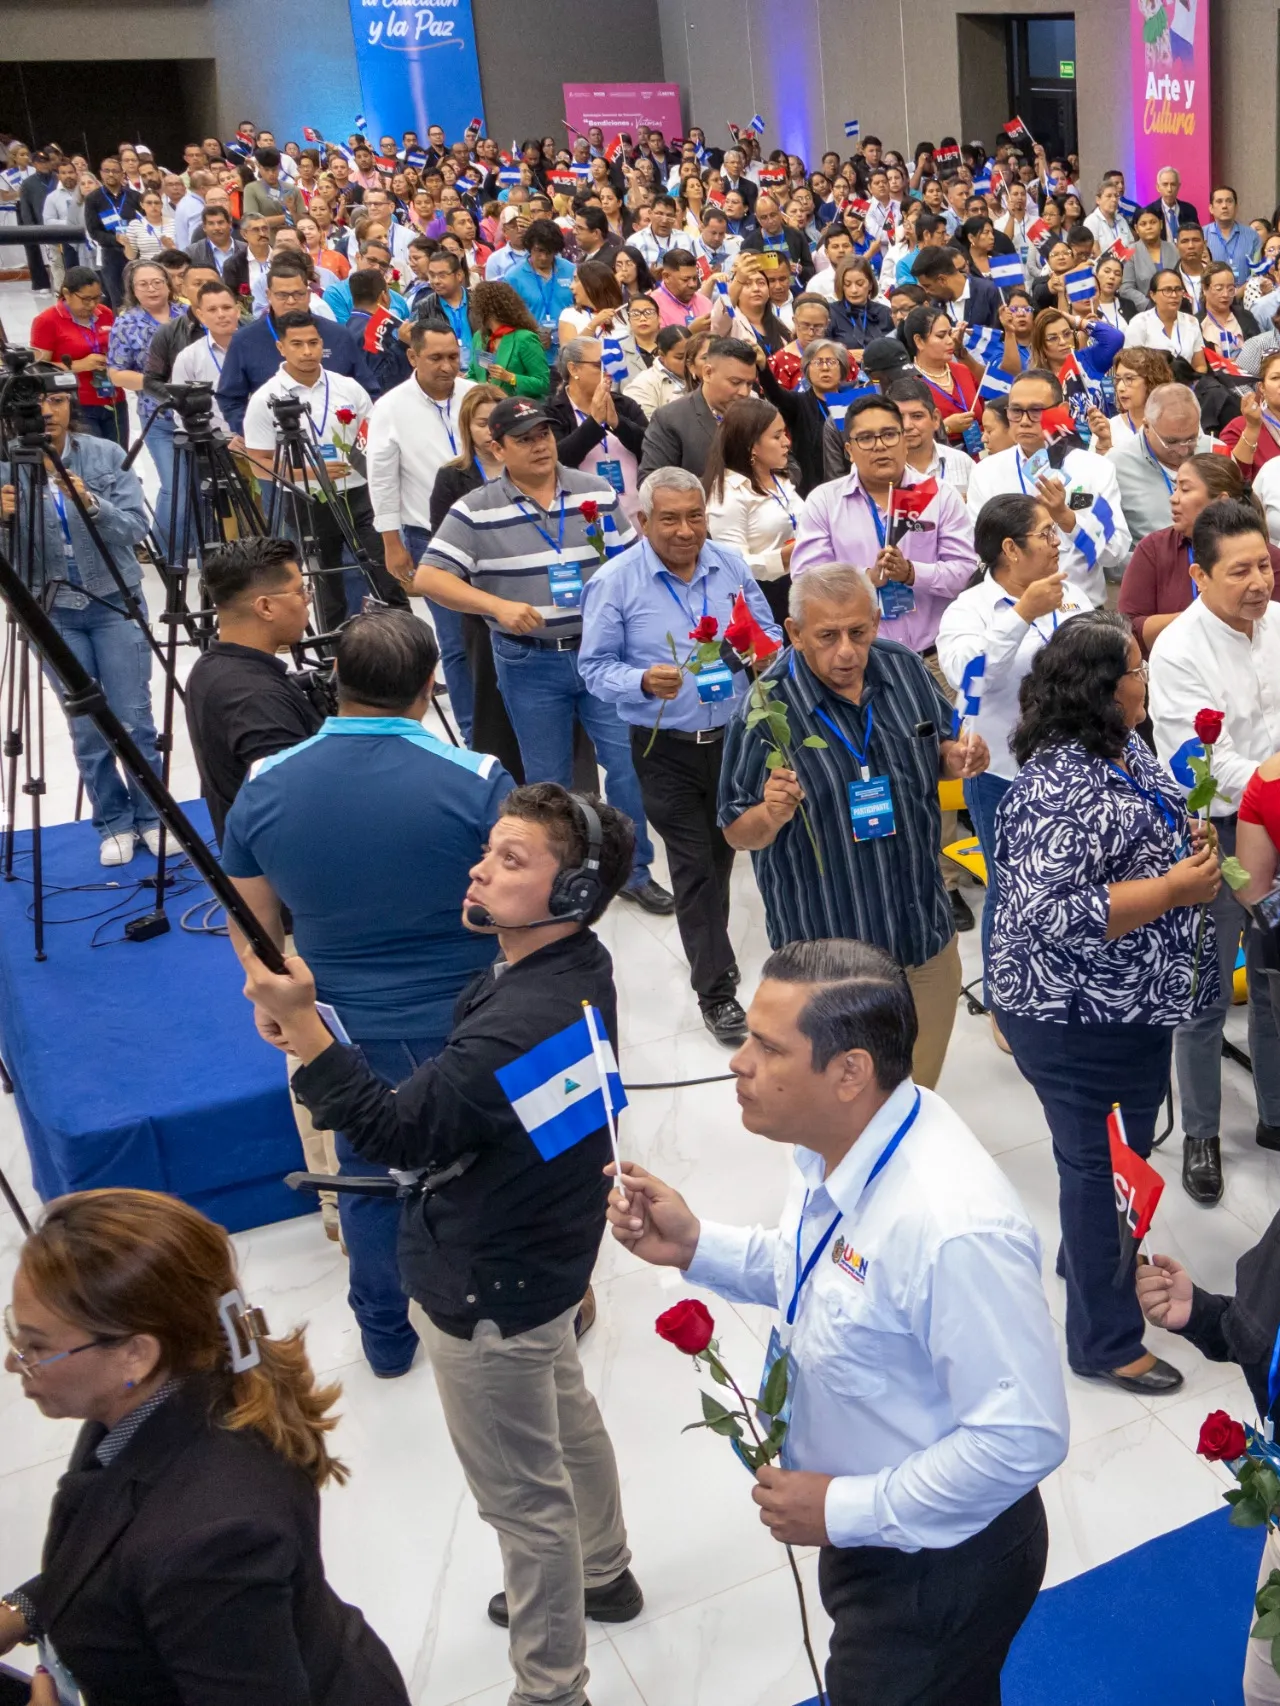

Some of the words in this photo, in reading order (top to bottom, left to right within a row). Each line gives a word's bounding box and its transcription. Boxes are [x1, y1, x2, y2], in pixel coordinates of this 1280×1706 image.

[368, 21, 384, 45] y
[386, 10, 409, 37] la
[414, 9, 455, 40] Paz
[1145, 71, 1181, 101] Arte
[1184, 80, 1195, 109] y
[1143, 96, 1195, 136] Cultura
[853, 802, 891, 816] PARTICIPANTE
